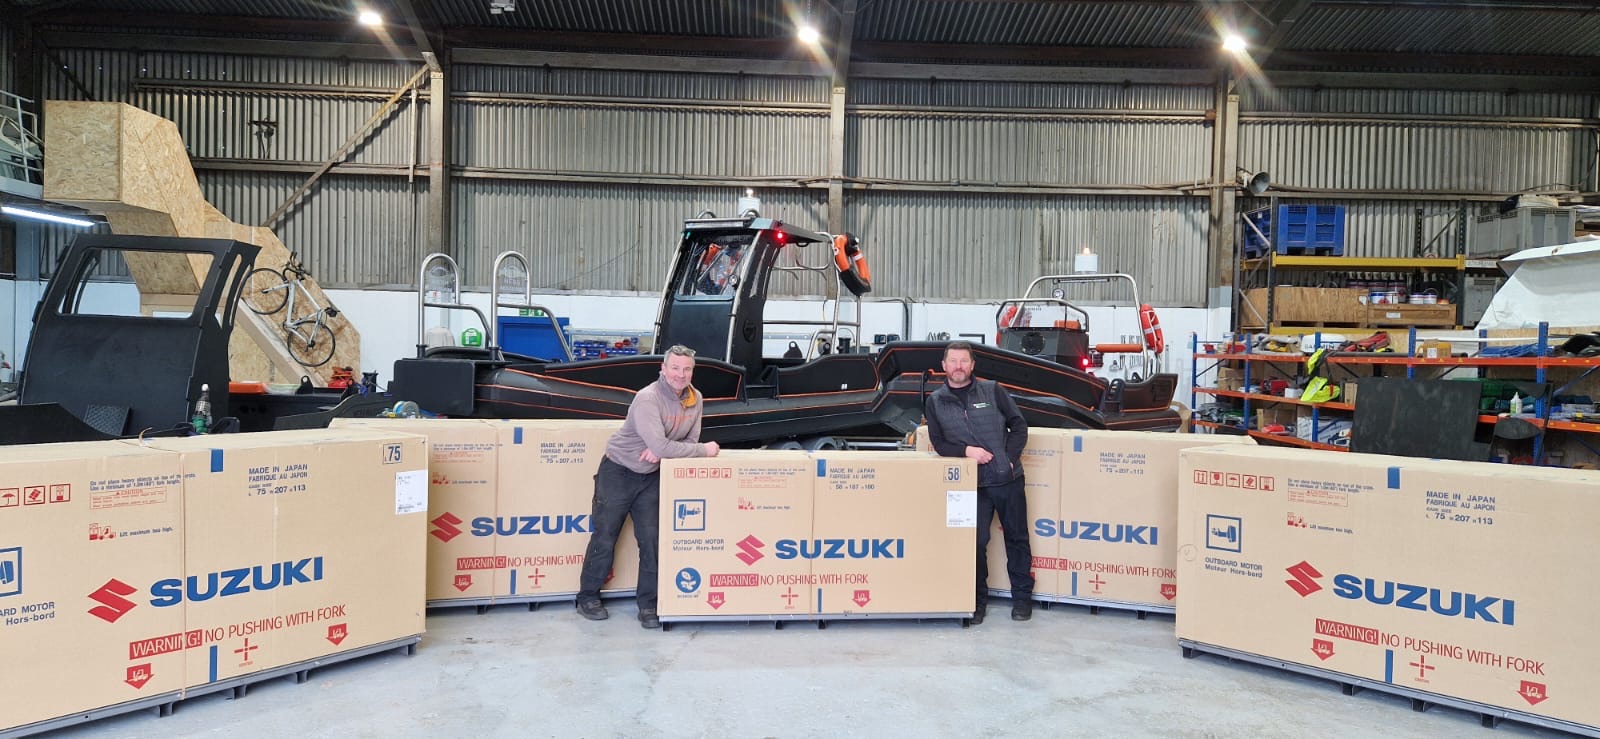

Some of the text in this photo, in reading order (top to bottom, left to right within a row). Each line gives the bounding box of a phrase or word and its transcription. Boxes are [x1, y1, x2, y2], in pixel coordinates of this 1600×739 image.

[388, 446, 400, 462] 75
[948, 468, 959, 480] 58
[1427, 491, 1448, 499] MADE
[1426, 499, 1457, 507] FABRIQUE
[1034, 518, 1158, 545] SUZUKI
[775, 538, 904, 559] SUZUKI
[459, 557, 505, 569] WARNING!
[508, 557, 521, 567] NO
[524, 556, 564, 566] PUSHING
[1032, 558, 1176, 579] ARNING! NO PUSHING WITH FORK
[1205, 557, 1237, 567] OUTBOARD
[1205, 564, 1226, 572] Moteur
[150, 556, 324, 608] SUZUKI
[712, 574, 868, 586] WARNING! NO PUSHING WITH FORK
[1333, 574, 1514, 626] SUZUKI
[22, 602, 55, 614] MOTOR
[6, 611, 55, 625] Hors-bord
[205, 627, 224, 643] NO
[229, 616, 282, 638] PUSHING
[286, 610, 314, 627] WITH
[318, 604, 346, 621] FORK
[1317, 620, 1544, 676] WARNING! NO PUSHING WITH FORK
